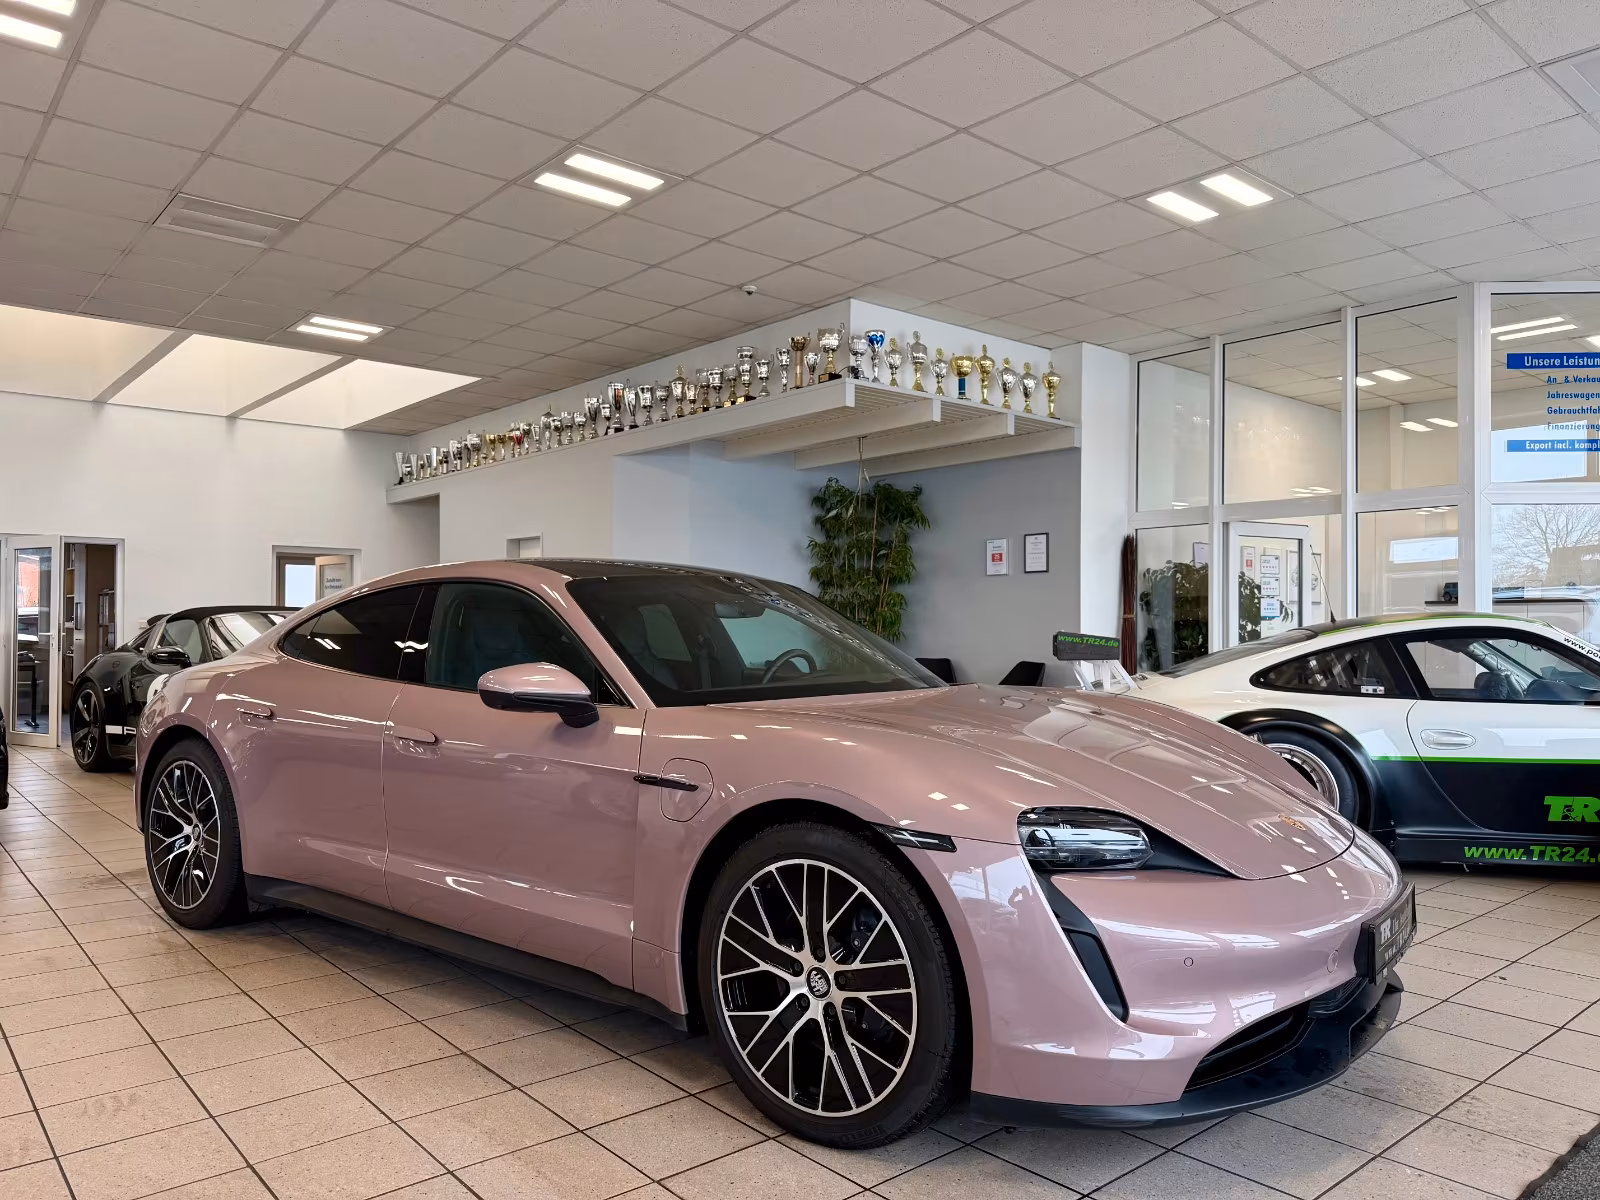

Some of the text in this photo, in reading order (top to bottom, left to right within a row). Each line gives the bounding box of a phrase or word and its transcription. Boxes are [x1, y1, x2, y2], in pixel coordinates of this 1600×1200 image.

[1524, 355, 1600, 367] Unsere Leistun
[1546, 375, 1557, 384] An
[1564, 375, 1570, 384] &
[1546, 391, 1600, 400] Jahreswagen
[1547, 422, 1600, 431] Finanzierung
[1525, 440, 1600, 450] Export incl. kompl
[1058, 635, 1119, 647] www.TR24.de
[1464, 845, 1600, 863] www.TR24.
